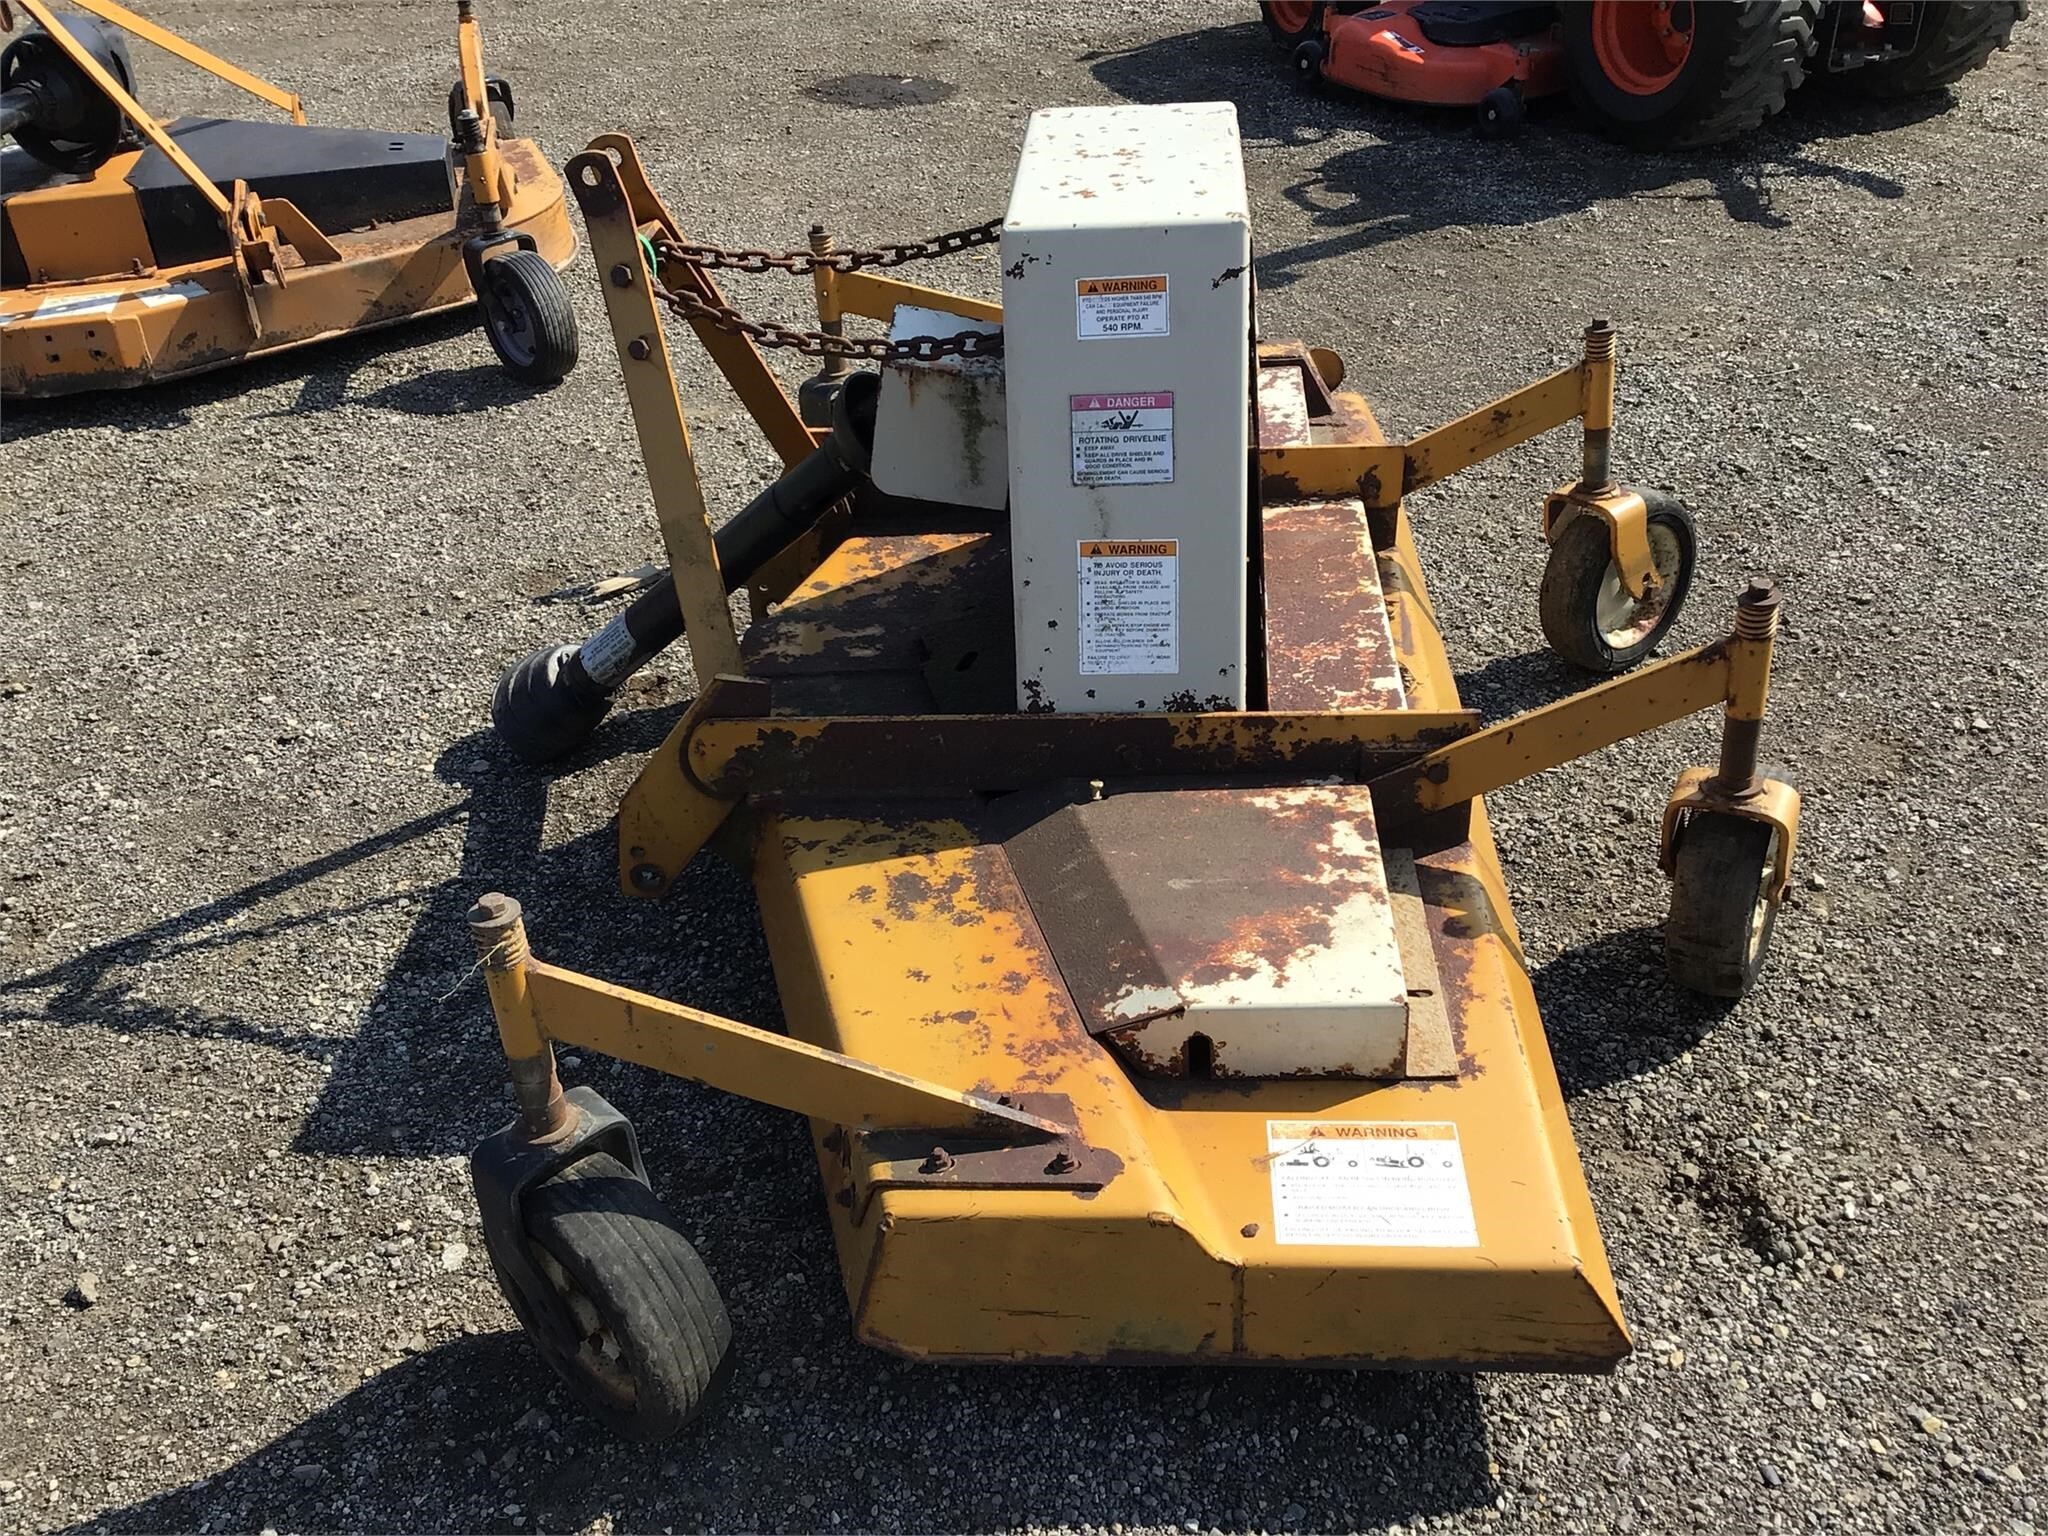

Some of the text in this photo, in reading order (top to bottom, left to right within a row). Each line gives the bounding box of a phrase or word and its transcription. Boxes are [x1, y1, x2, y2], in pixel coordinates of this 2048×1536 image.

[1101, 280, 1157, 293] WARNING
[1102, 323, 1118, 332] 540
[1107, 396, 1155, 408] DANGER
[1078, 434, 1167, 444] ROTATING DRIVELINE
[1108, 544, 1167, 555] WARNING
[1335, 1127, 1419, 1138] WARNING
